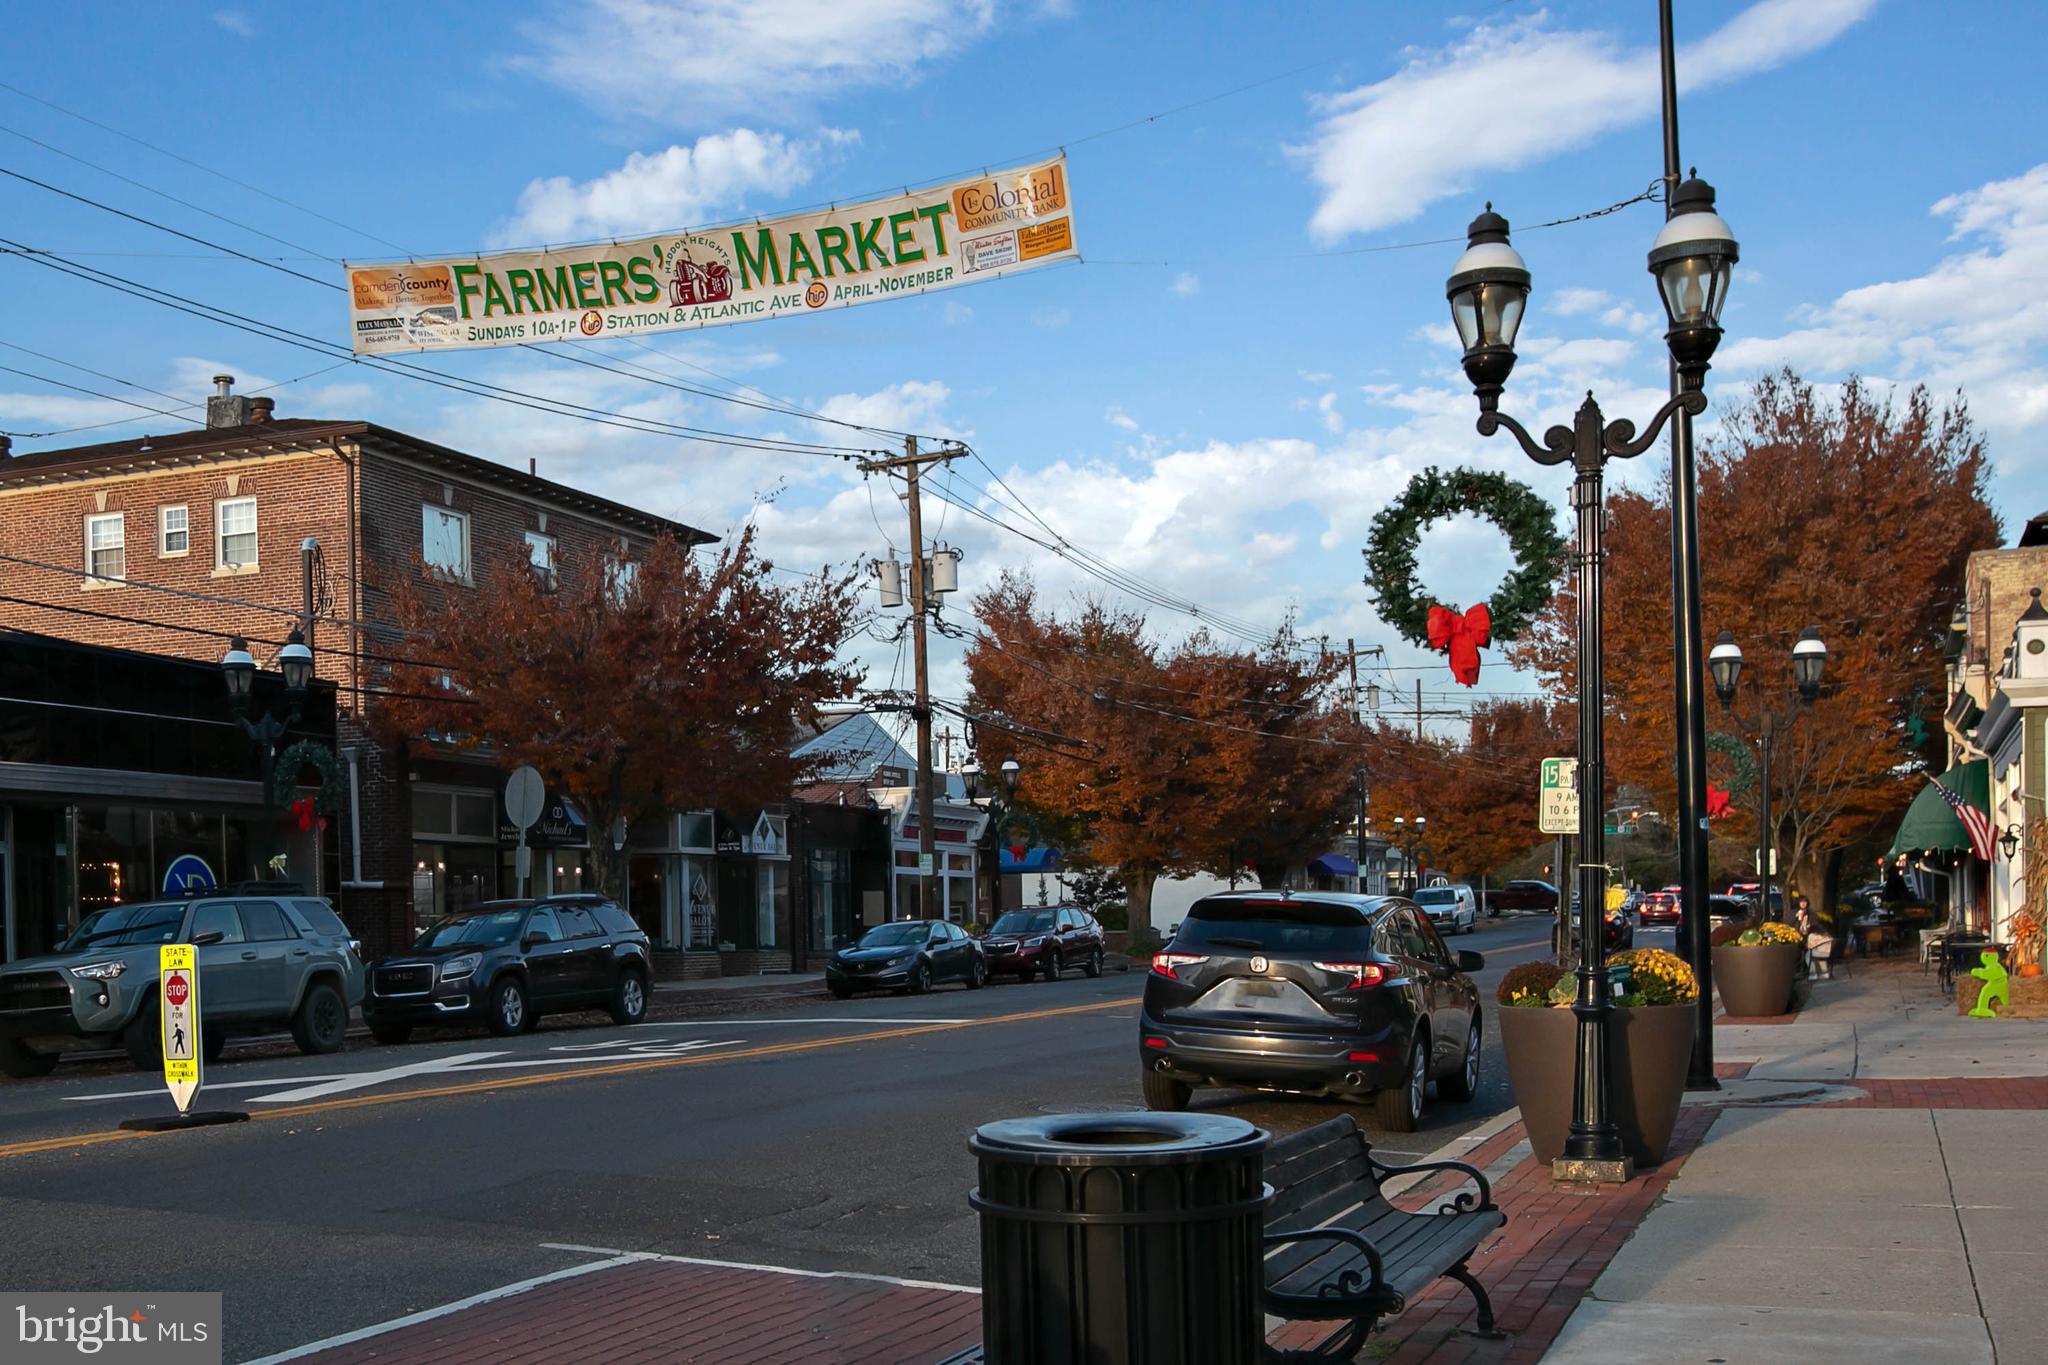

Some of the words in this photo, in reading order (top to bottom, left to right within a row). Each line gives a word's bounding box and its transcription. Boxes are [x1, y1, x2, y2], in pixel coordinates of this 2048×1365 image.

[961, 168, 1058, 216] Colonial
[964, 207, 1029, 230] COMMUNITY
[1033, 198, 1060, 214] BANK
[452, 243, 664, 320] FARMERS'
[730, 200, 951, 291] MARKET
[665, 239, 687, 274] HADDON
[689, 236, 731, 266] HEIGHTS
[354, 280, 400, 294] camden
[406, 278, 450, 291] county
[468, 324, 525, 342] SUNDAYS
[531, 318, 577, 336] 10A-1P
[607, 312, 669, 330] STATION
[674, 308, 687, 323] &
[690, 300, 765, 321] ATLANTIC
[769, 293, 802, 311] AVE
[833, 266, 954, 301] APRIL-NOVEMBER
[1544, 765, 1558, 784] 15
[1556, 792, 1563, 802] 9
[1549, 805, 1560, 815] TO
[1563, 805, 1570, 815] 6
[166, 947, 188, 957] STATE
[168, 958, 184, 967] LAW
[167, 985, 187, 997] STOP
